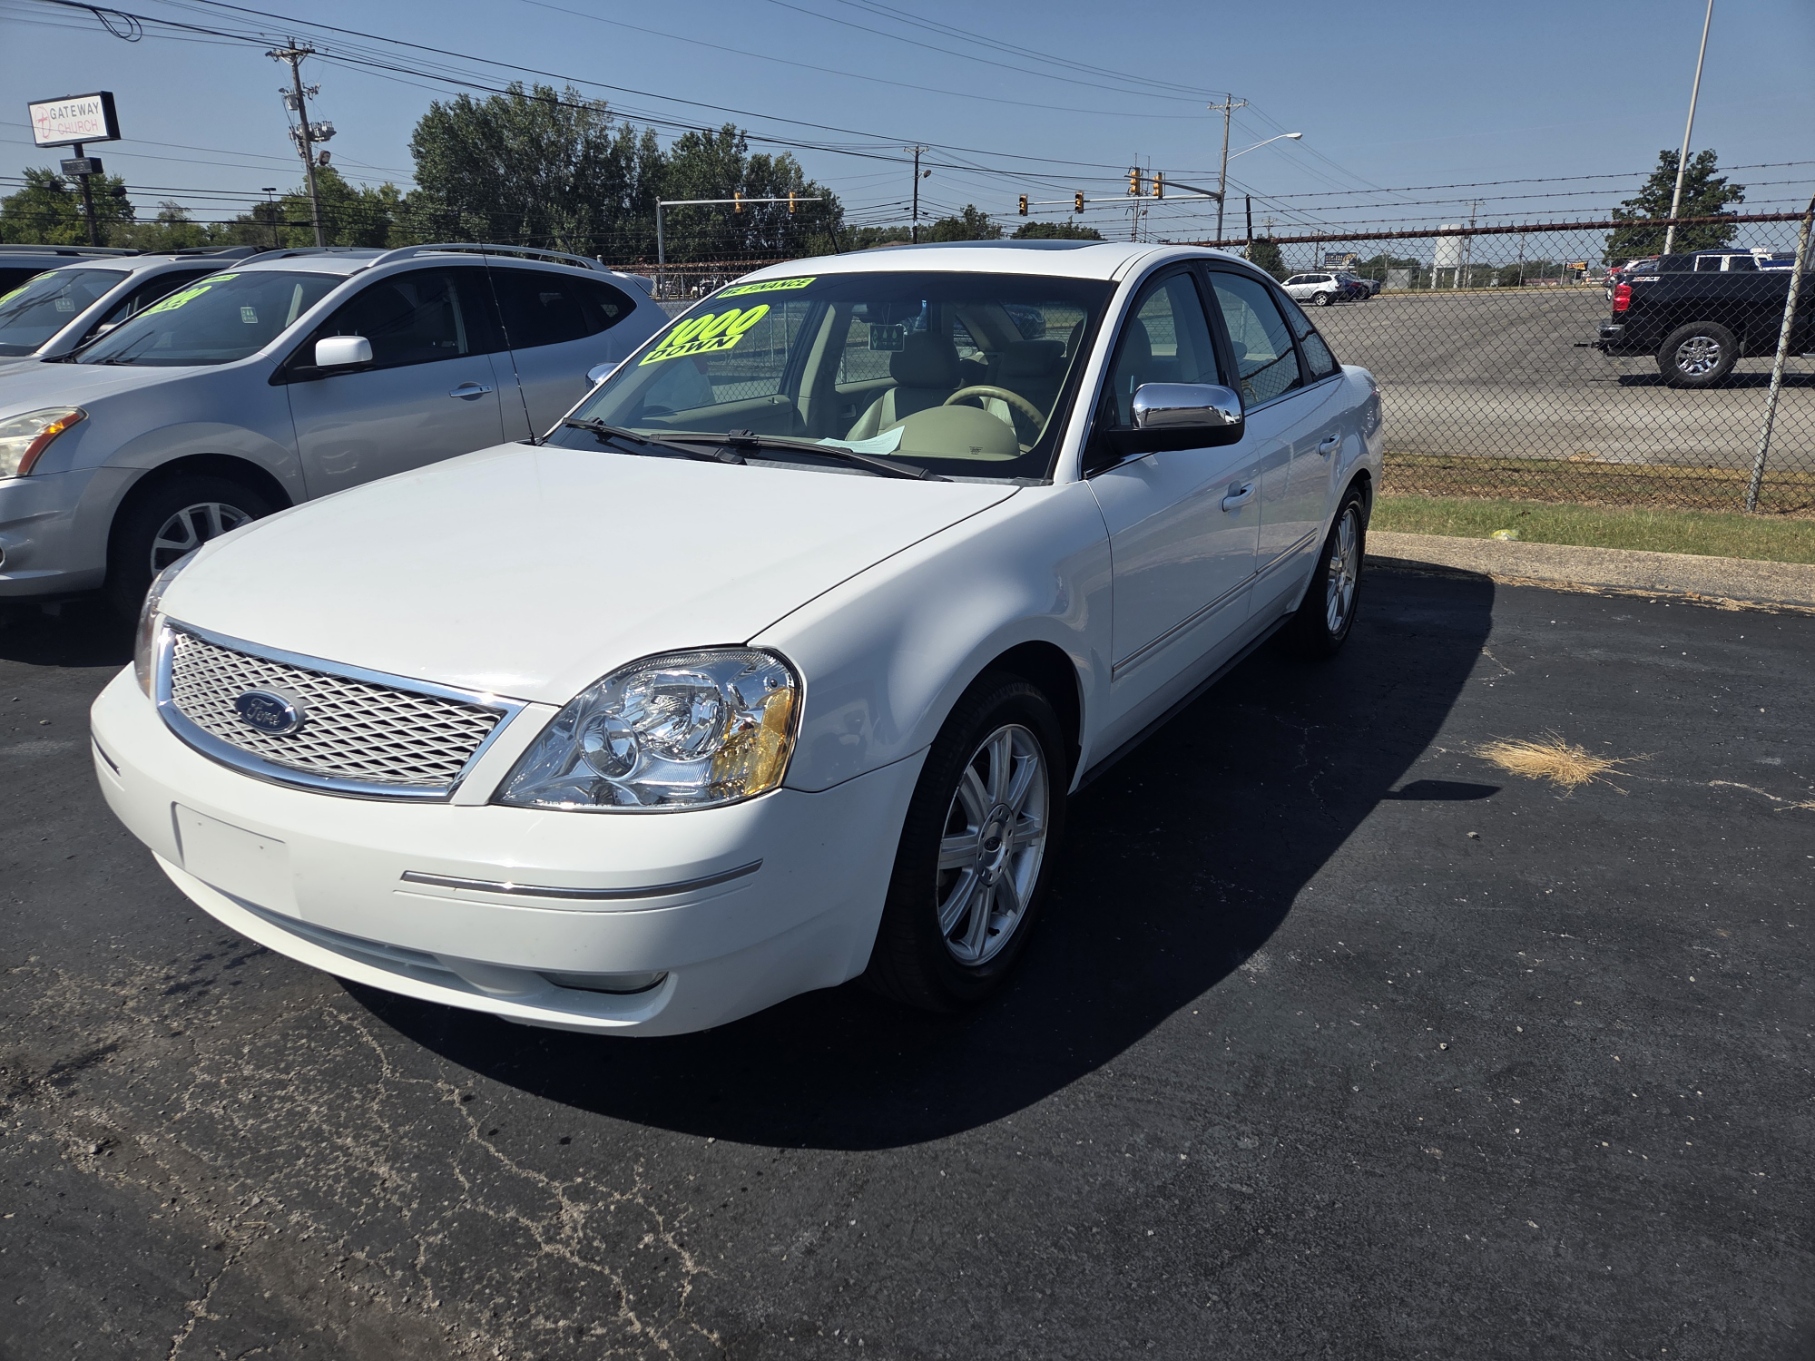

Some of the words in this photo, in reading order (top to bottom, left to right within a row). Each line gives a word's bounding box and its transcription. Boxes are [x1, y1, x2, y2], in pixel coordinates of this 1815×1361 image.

[50, 102, 99, 120] GATEWAY
[58, 119, 99, 135] CHURCH
[743, 278, 812, 293] FINANCE
[656, 304, 770, 350] 1000
[646, 336, 734, 362] DOWN
[246, 697, 281, 727] Ford
